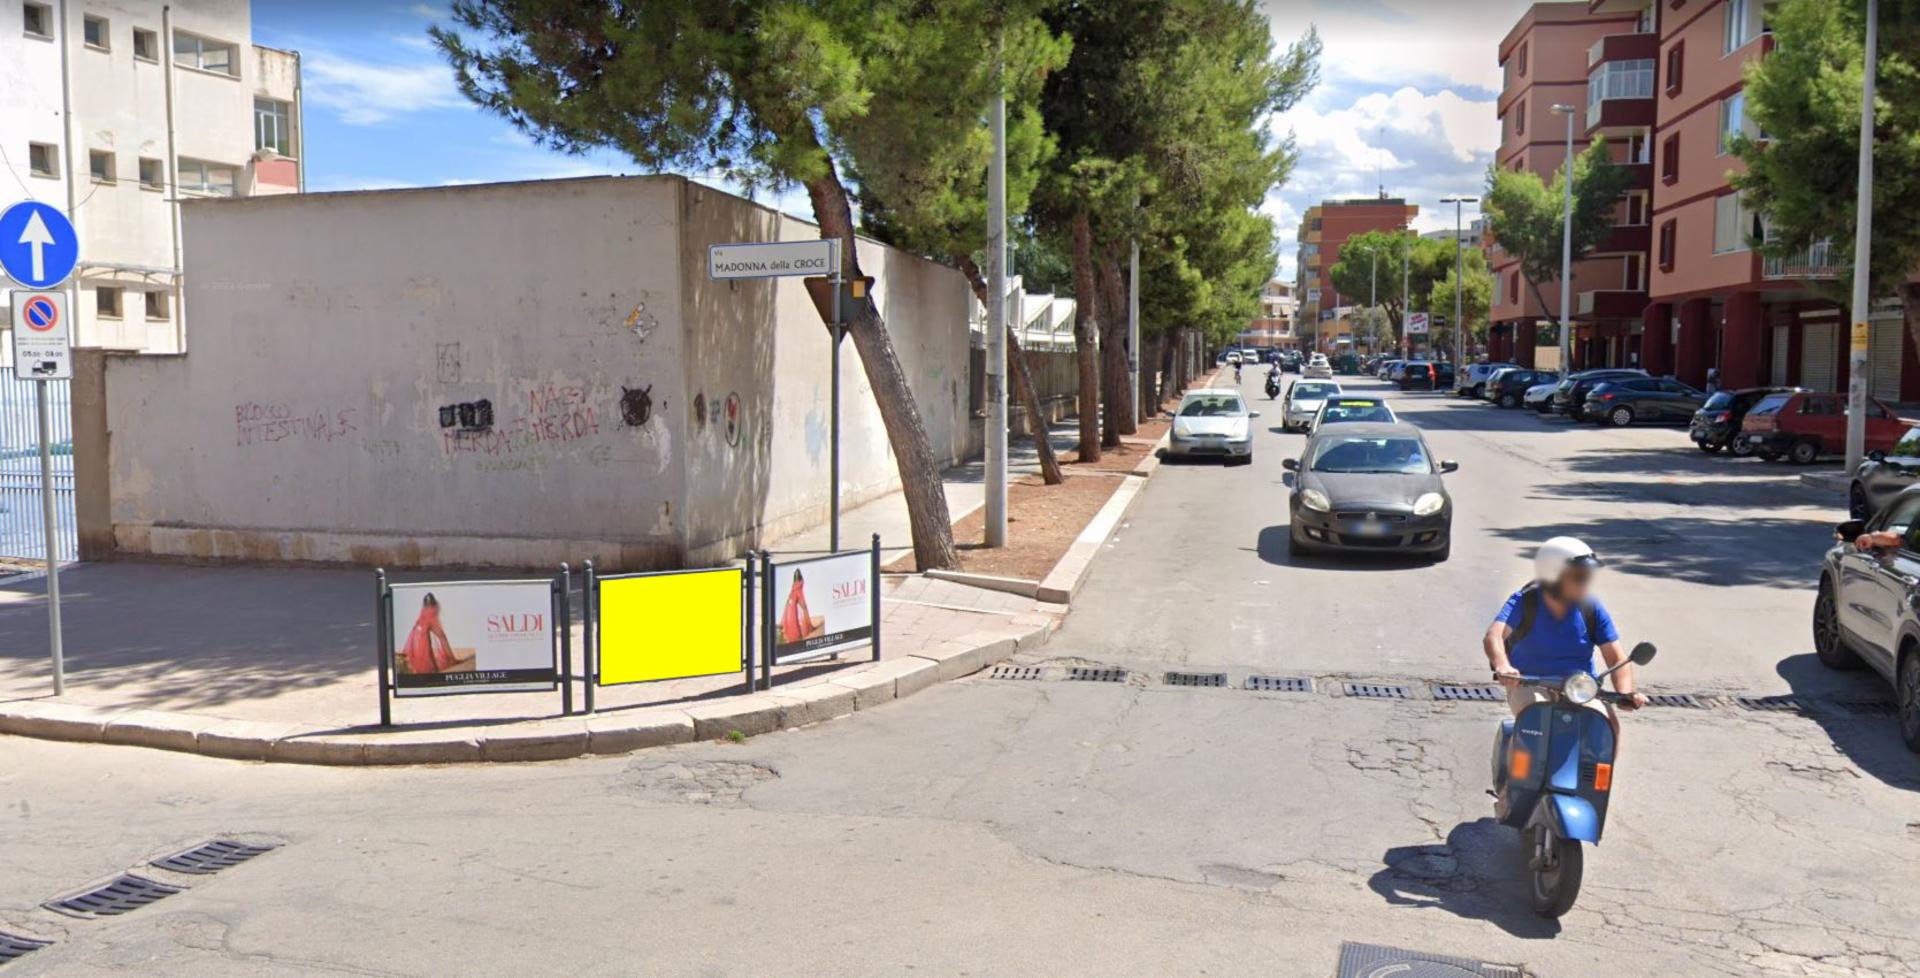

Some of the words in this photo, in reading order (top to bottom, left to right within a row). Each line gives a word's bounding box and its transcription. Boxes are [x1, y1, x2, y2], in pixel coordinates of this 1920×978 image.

[715, 262, 768, 272] MADONNA
[770, 261, 790, 270] della
[794, 258, 825, 269] CROCE
[832, 579, 867, 599] SALDI
[487, 614, 543, 632] SALDI
[475, 671, 508, 680] VILLAGE
